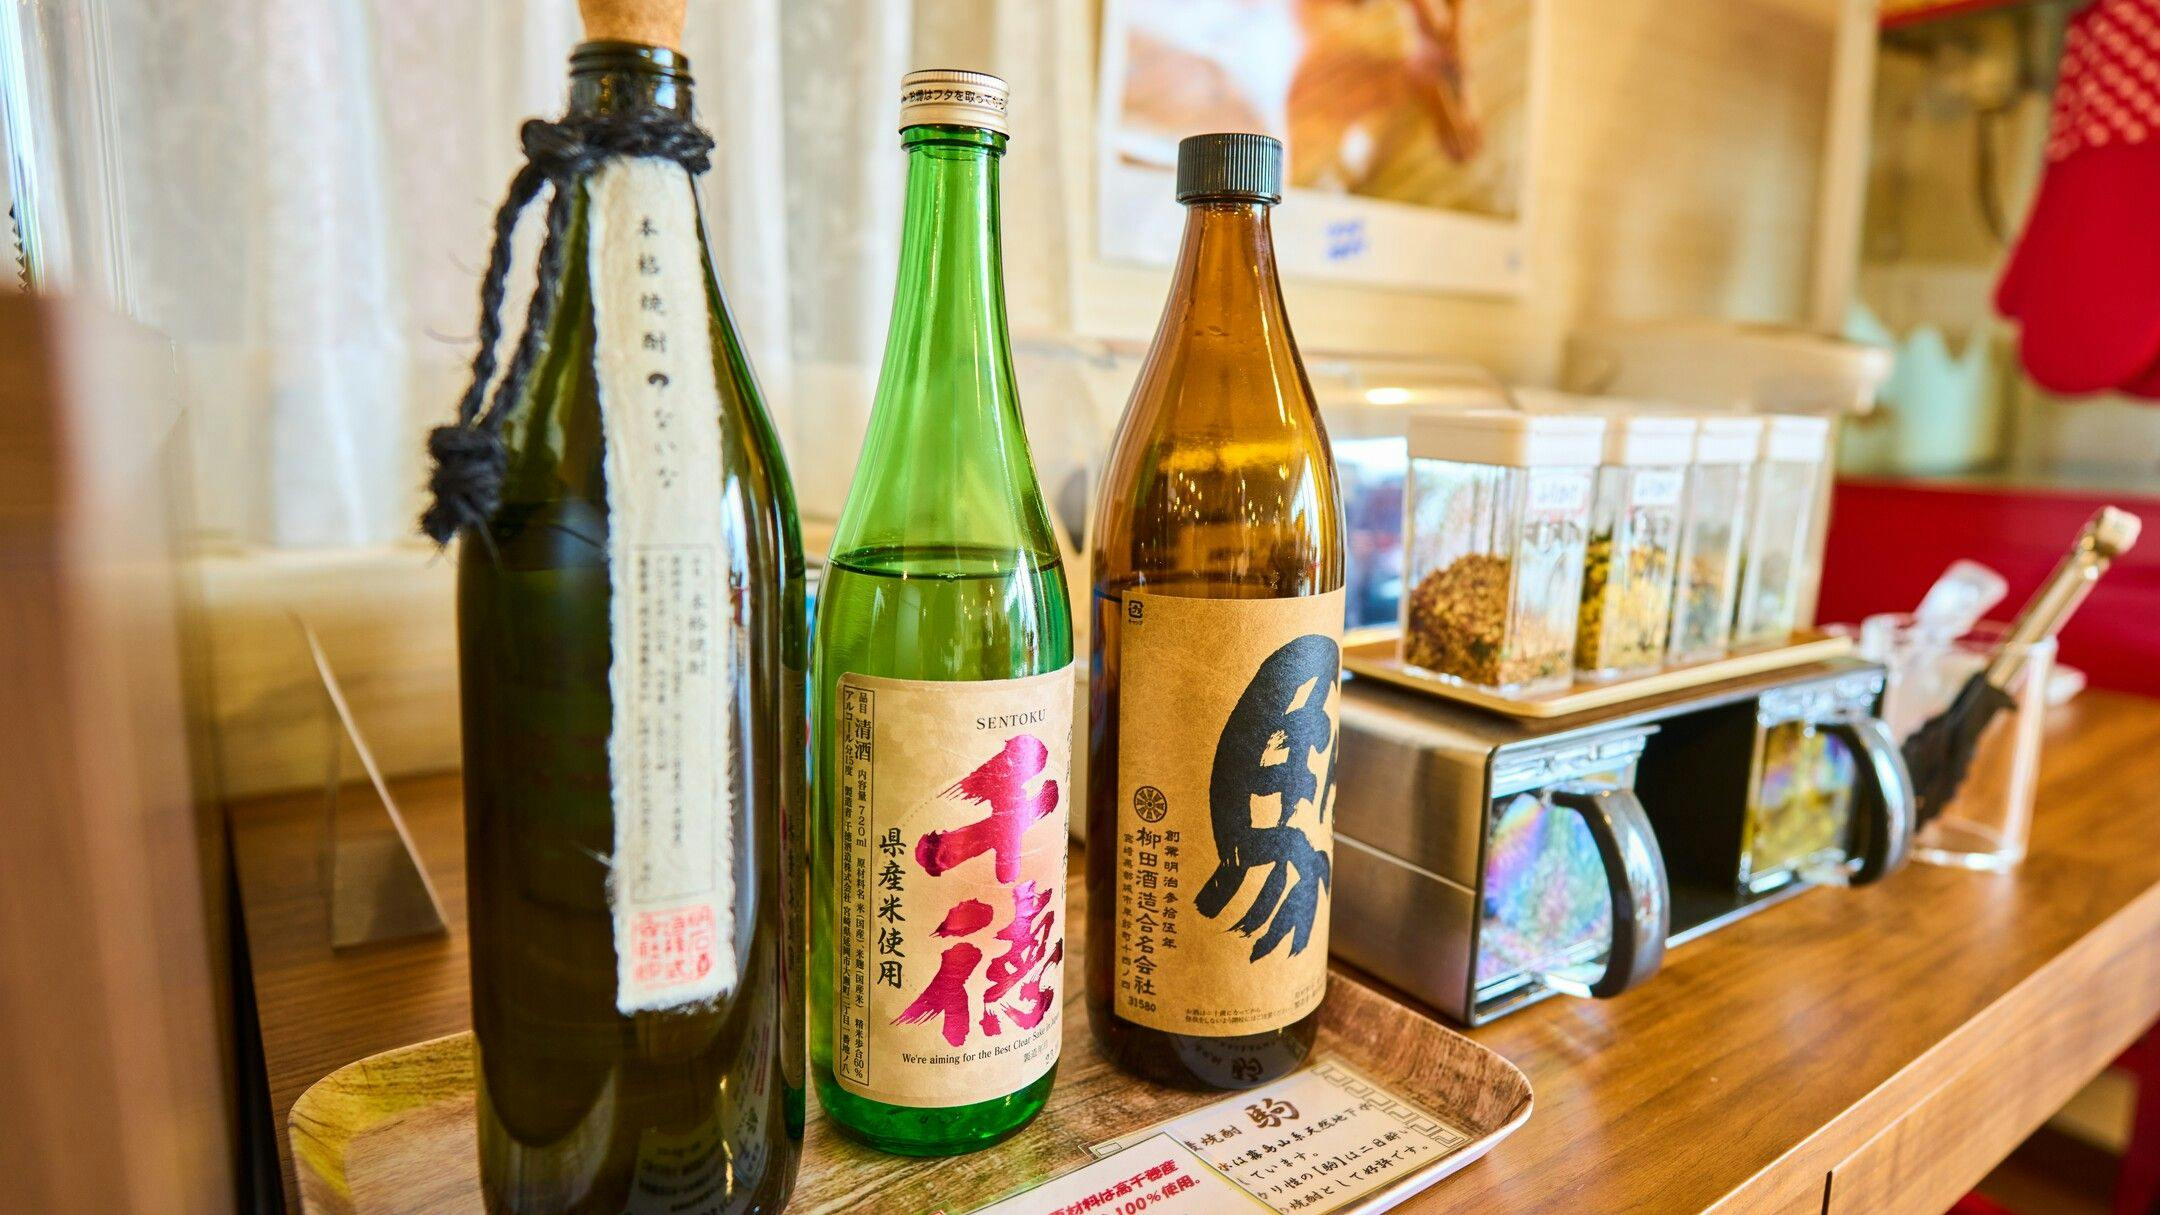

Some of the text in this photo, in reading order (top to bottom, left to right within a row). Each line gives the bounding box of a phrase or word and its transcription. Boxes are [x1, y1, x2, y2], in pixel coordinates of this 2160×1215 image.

[858, 692, 868, 714] 品目
[976, 708, 1047, 731] SENTOKU
[845, 690, 855, 776] アルコール分15度
[855, 718, 872, 762] 清酒
[857, 769, 867, 801] 内容量
[856, 805, 867, 847] 720ml
[856, 858, 866, 899] 原材料名
[876, 828, 907, 989] 県産米使用
[1133, 826, 1161, 996] 柳田酒造合名会社
[1127, 996, 1157, 1012] 31580
[902, 1053, 927, 1065] We're
[929, 1054, 960, 1066] aiming
[962, 1052, 977, 1063] for
[978, 1049, 992, 1061] the
[994, 1044, 1011, 1057] Best
[1013, 1036, 1031, 1050] Clear
[1245, 1098, 1300, 1128] 駒
